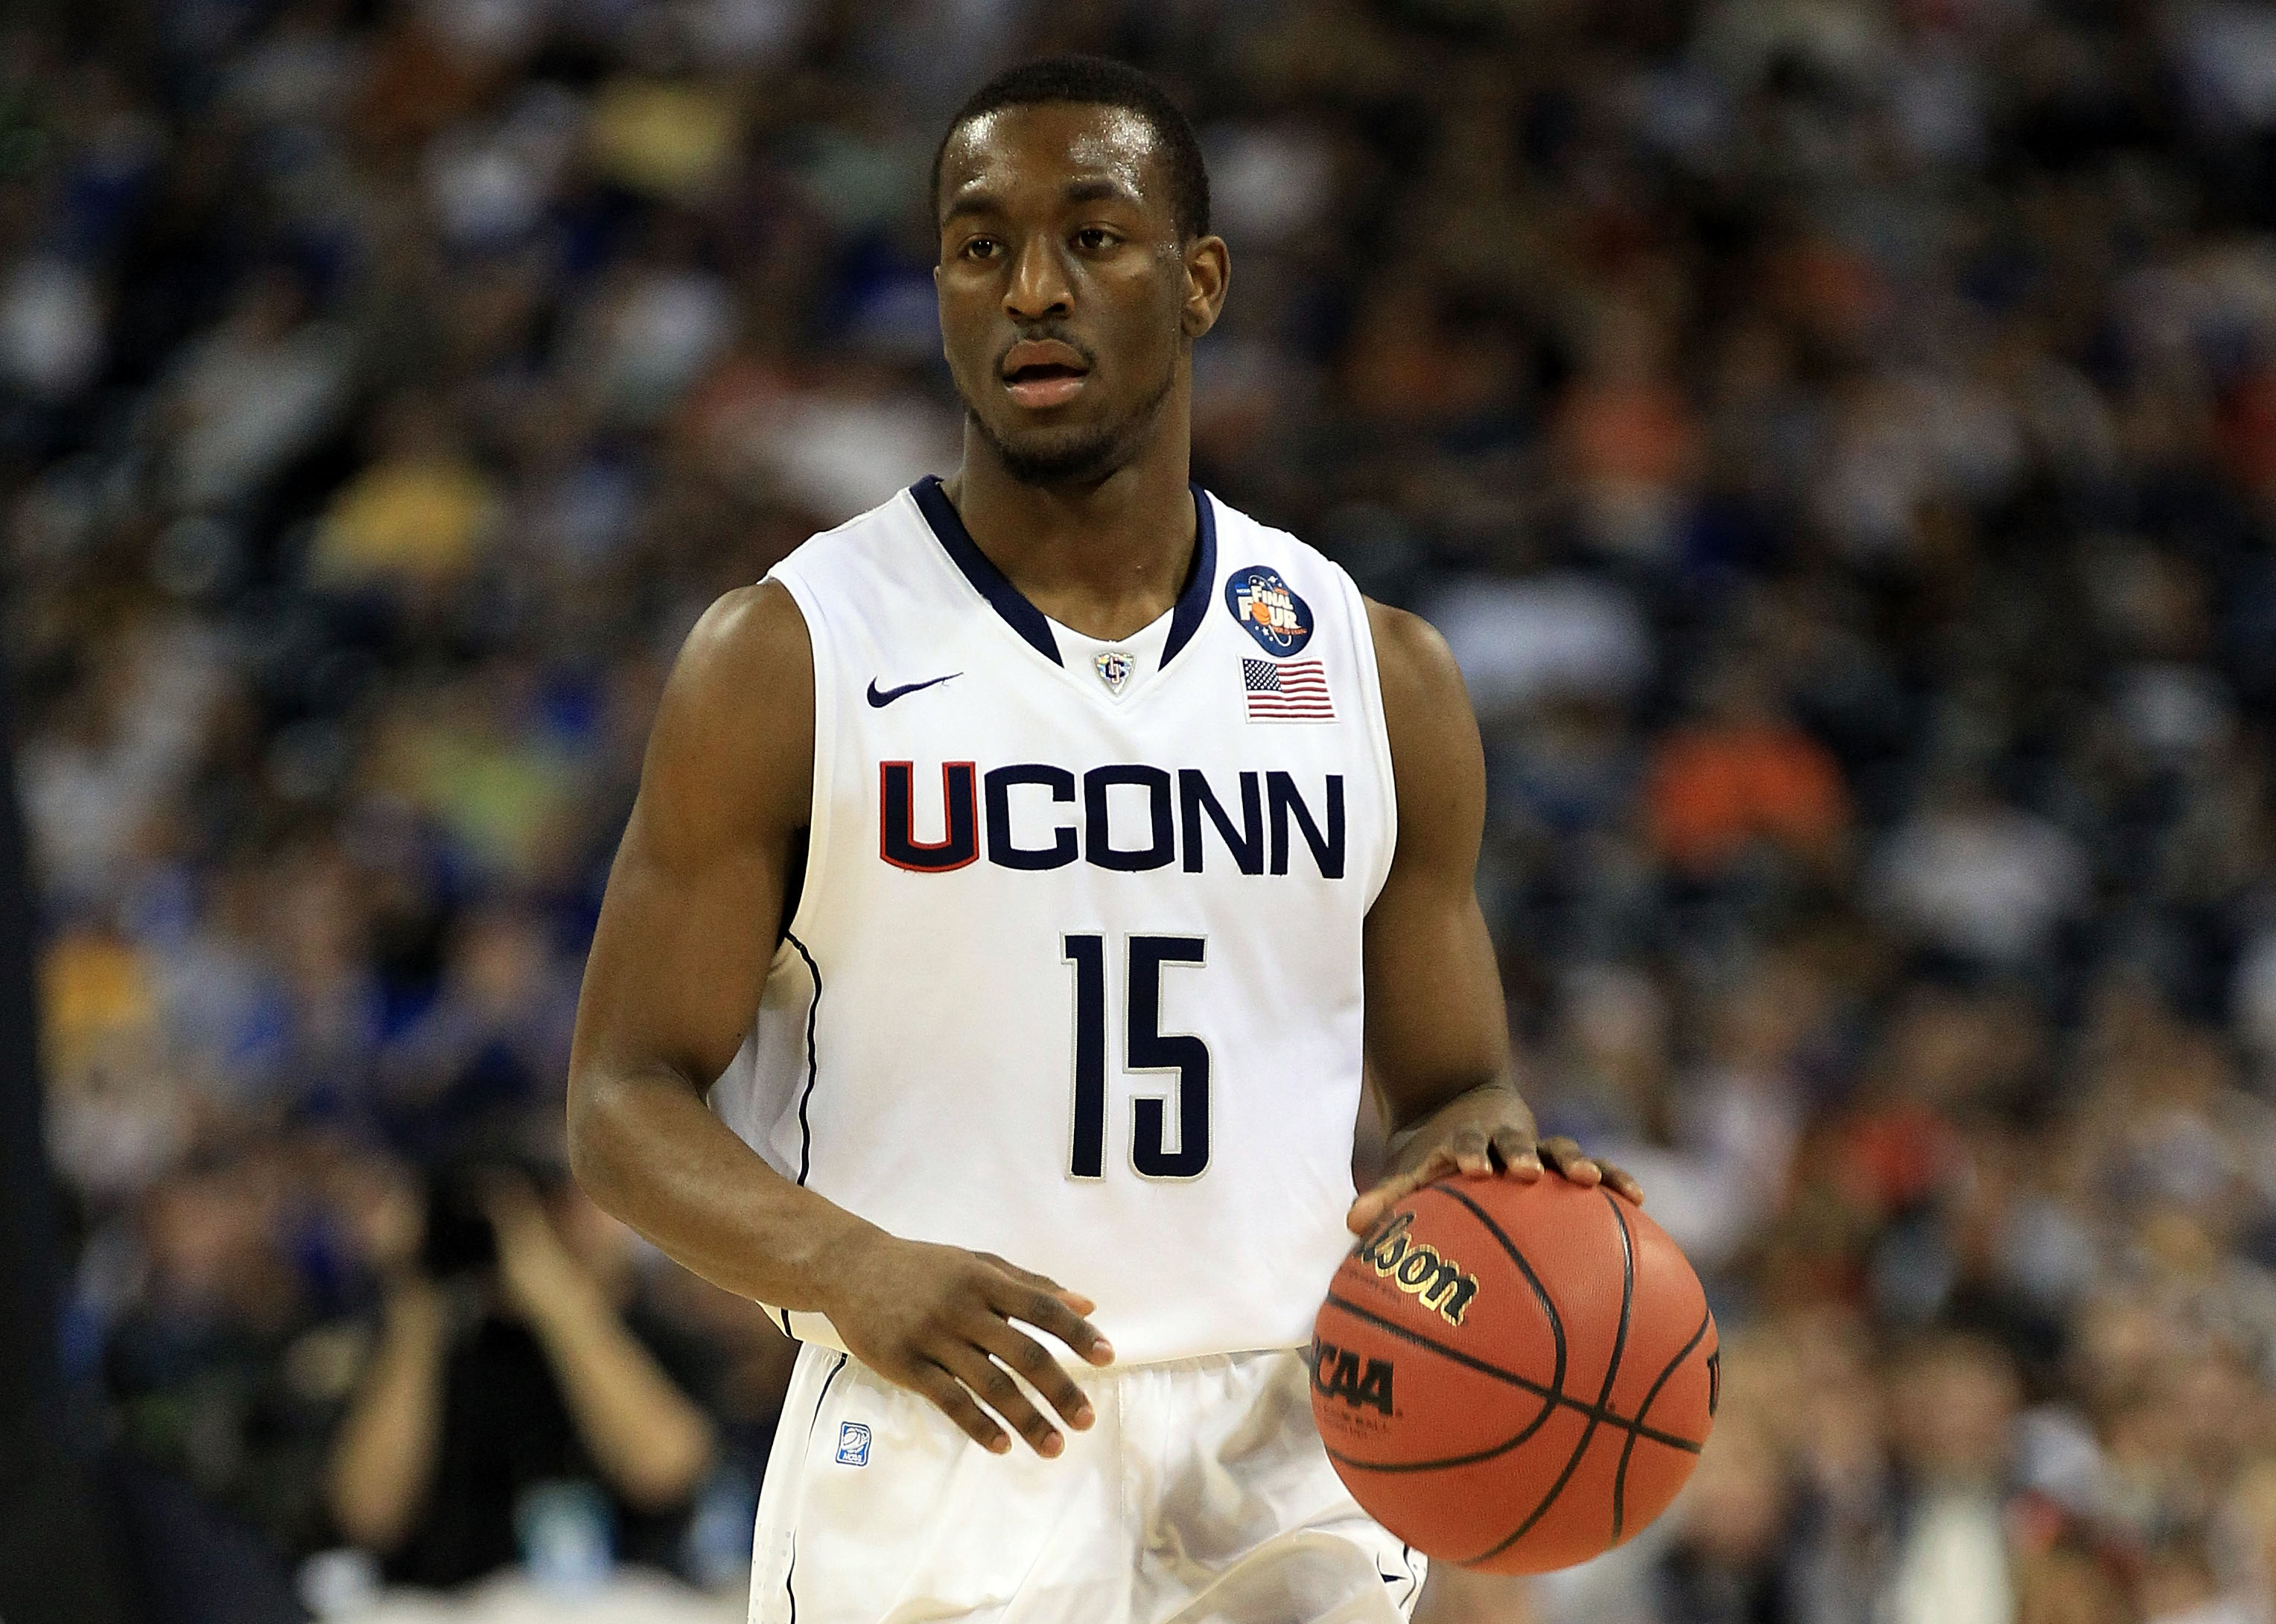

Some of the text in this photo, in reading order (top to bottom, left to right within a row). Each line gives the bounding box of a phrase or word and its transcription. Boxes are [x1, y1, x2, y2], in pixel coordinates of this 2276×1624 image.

[1251, 585, 1294, 610] FINAL
[880, 760, 1346, 879] UCONN
[1059, 930, 1213, 1182] 15
